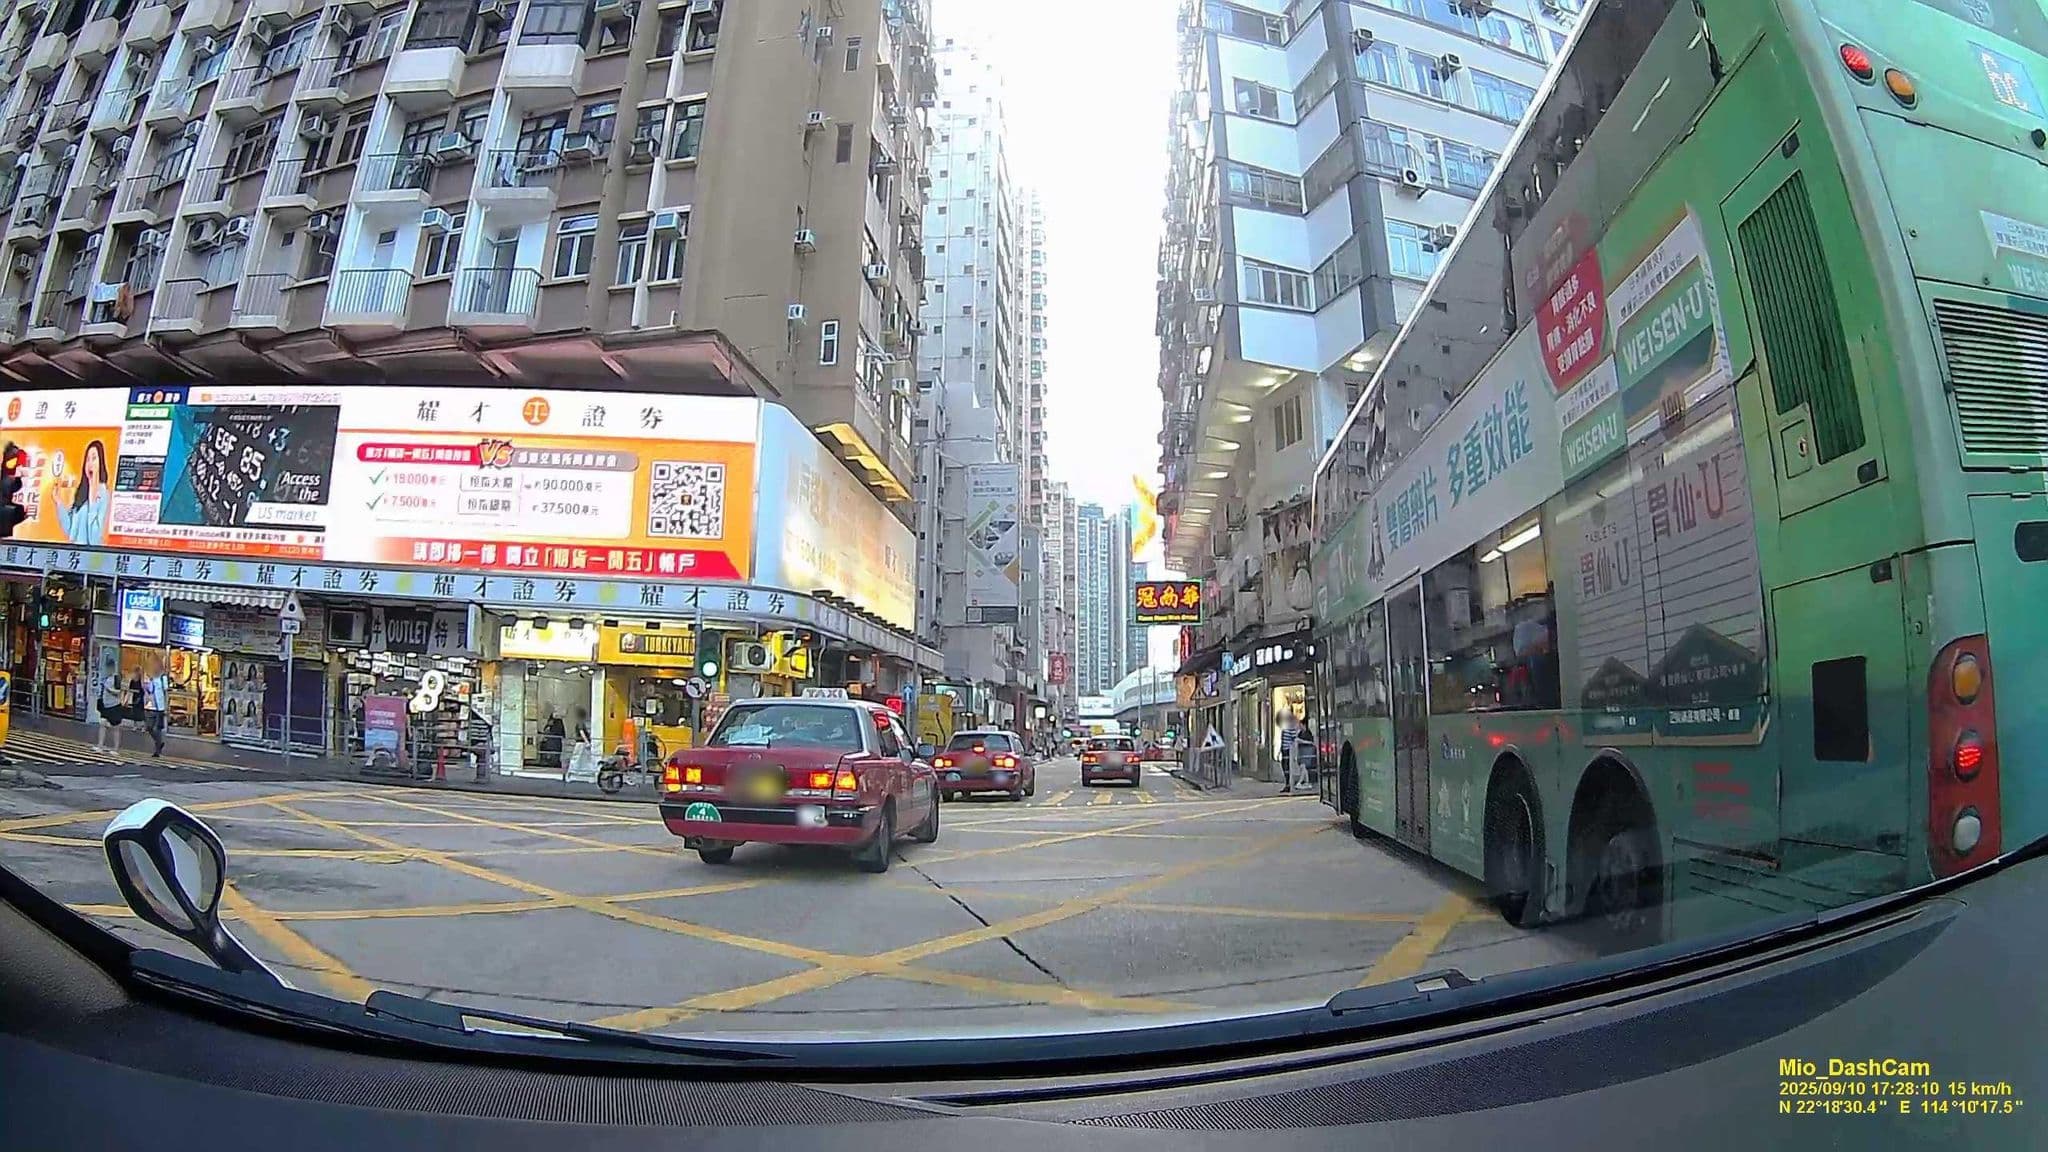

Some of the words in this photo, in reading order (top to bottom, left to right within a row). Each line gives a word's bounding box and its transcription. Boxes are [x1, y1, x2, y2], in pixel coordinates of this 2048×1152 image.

[1622, 280, 1705, 376] WEISEN-U
[1446, 379, 1535, 510] 多重效能
[1566, 413, 1617, 468] WEISEN-U
[282, 471, 321, 485] Access
[299, 487, 320, 502] the
[258, 507, 273, 519] US
[275, 507, 318, 522] market
[115, 553, 212, 580] 耀才證券
[256, 563, 380, 591] 耀才證券
[432, 573, 577, 602] 耀才證券
[638, 585, 786, 615] 耀才證券
[387, 619, 430, 645] OUTLET
[808, 688, 845, 698] TAXI
